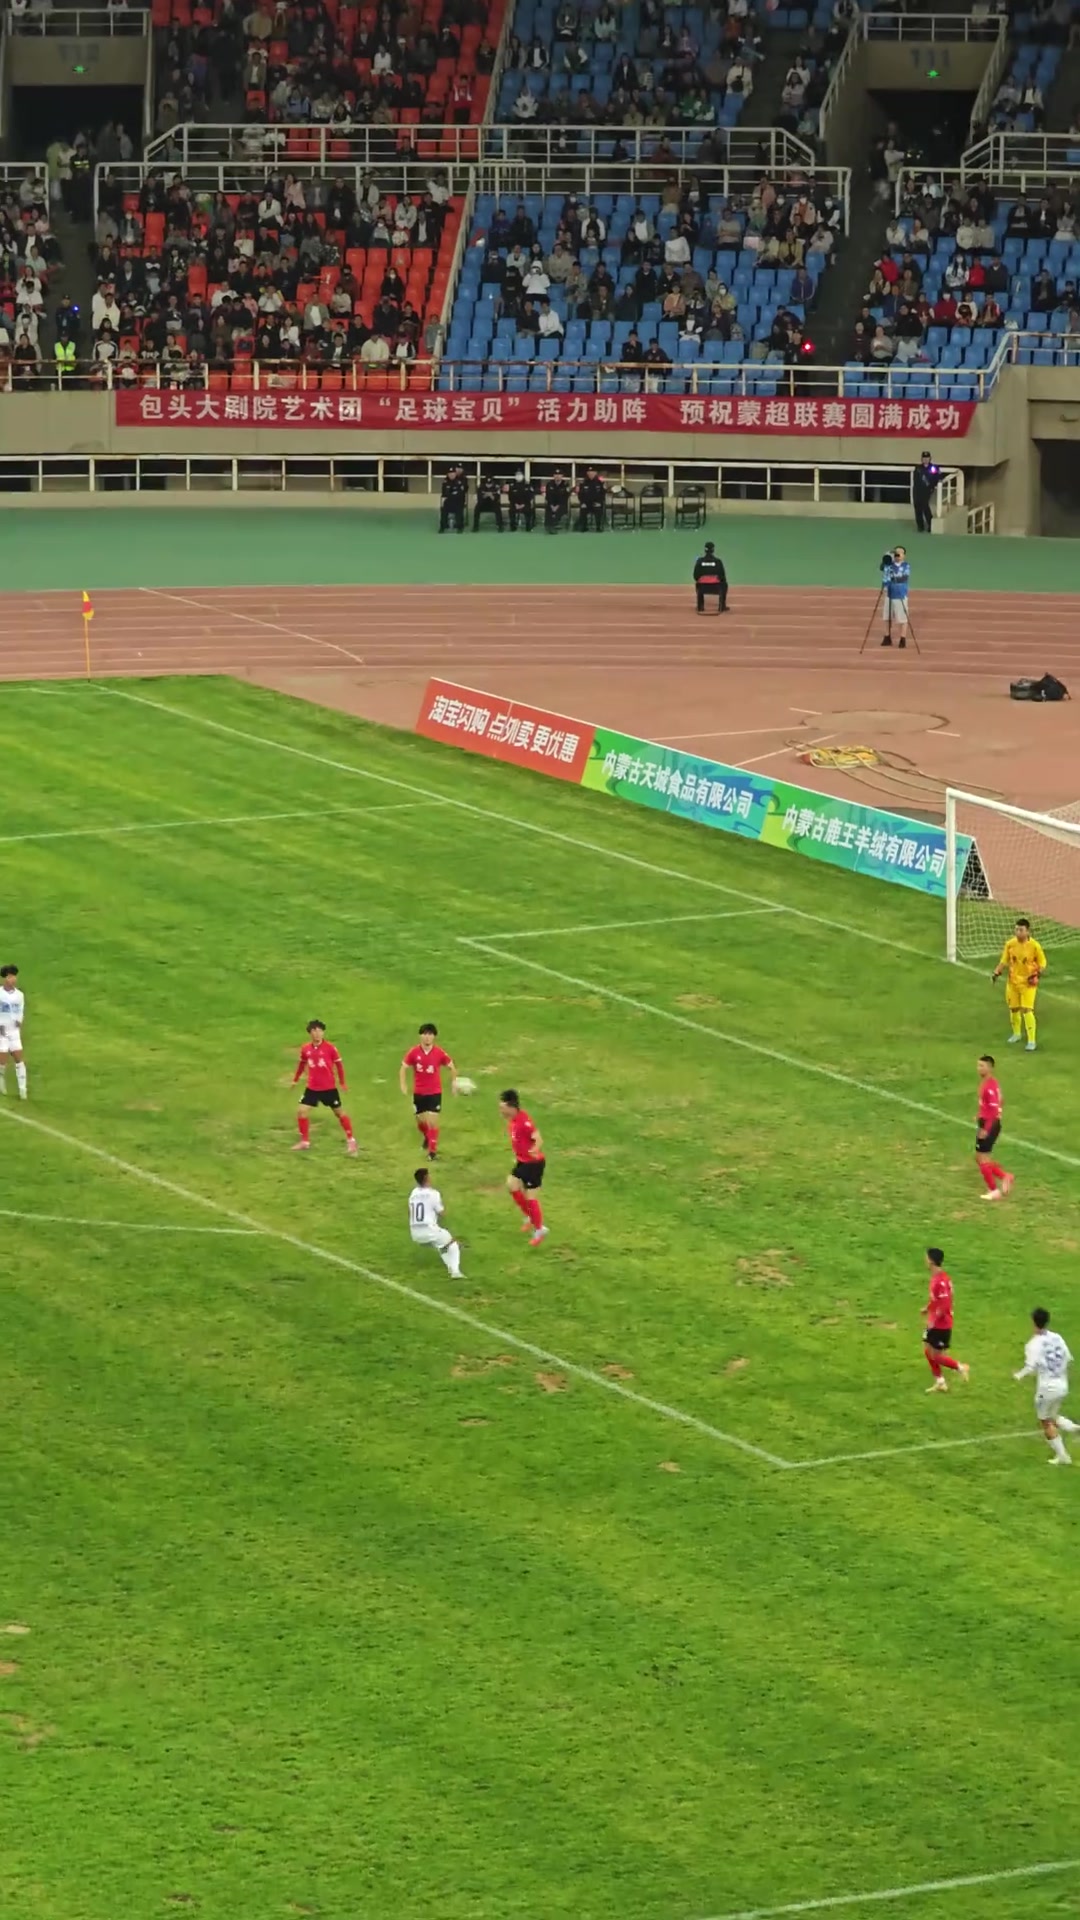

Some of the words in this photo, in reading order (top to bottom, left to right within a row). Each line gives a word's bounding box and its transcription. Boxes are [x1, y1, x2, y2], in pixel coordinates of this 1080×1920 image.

[679, 400, 960, 431] 预祝蒙超联赛圆满成功
[428, 695, 491, 736] 淘宝闪购
[602, 749, 754, 819] 内蒙古天城食品有限公司
[782, 804, 947, 878] 内蒙古鹿王羊绒有限公司
[410, 1202, 425, 1222] 10
